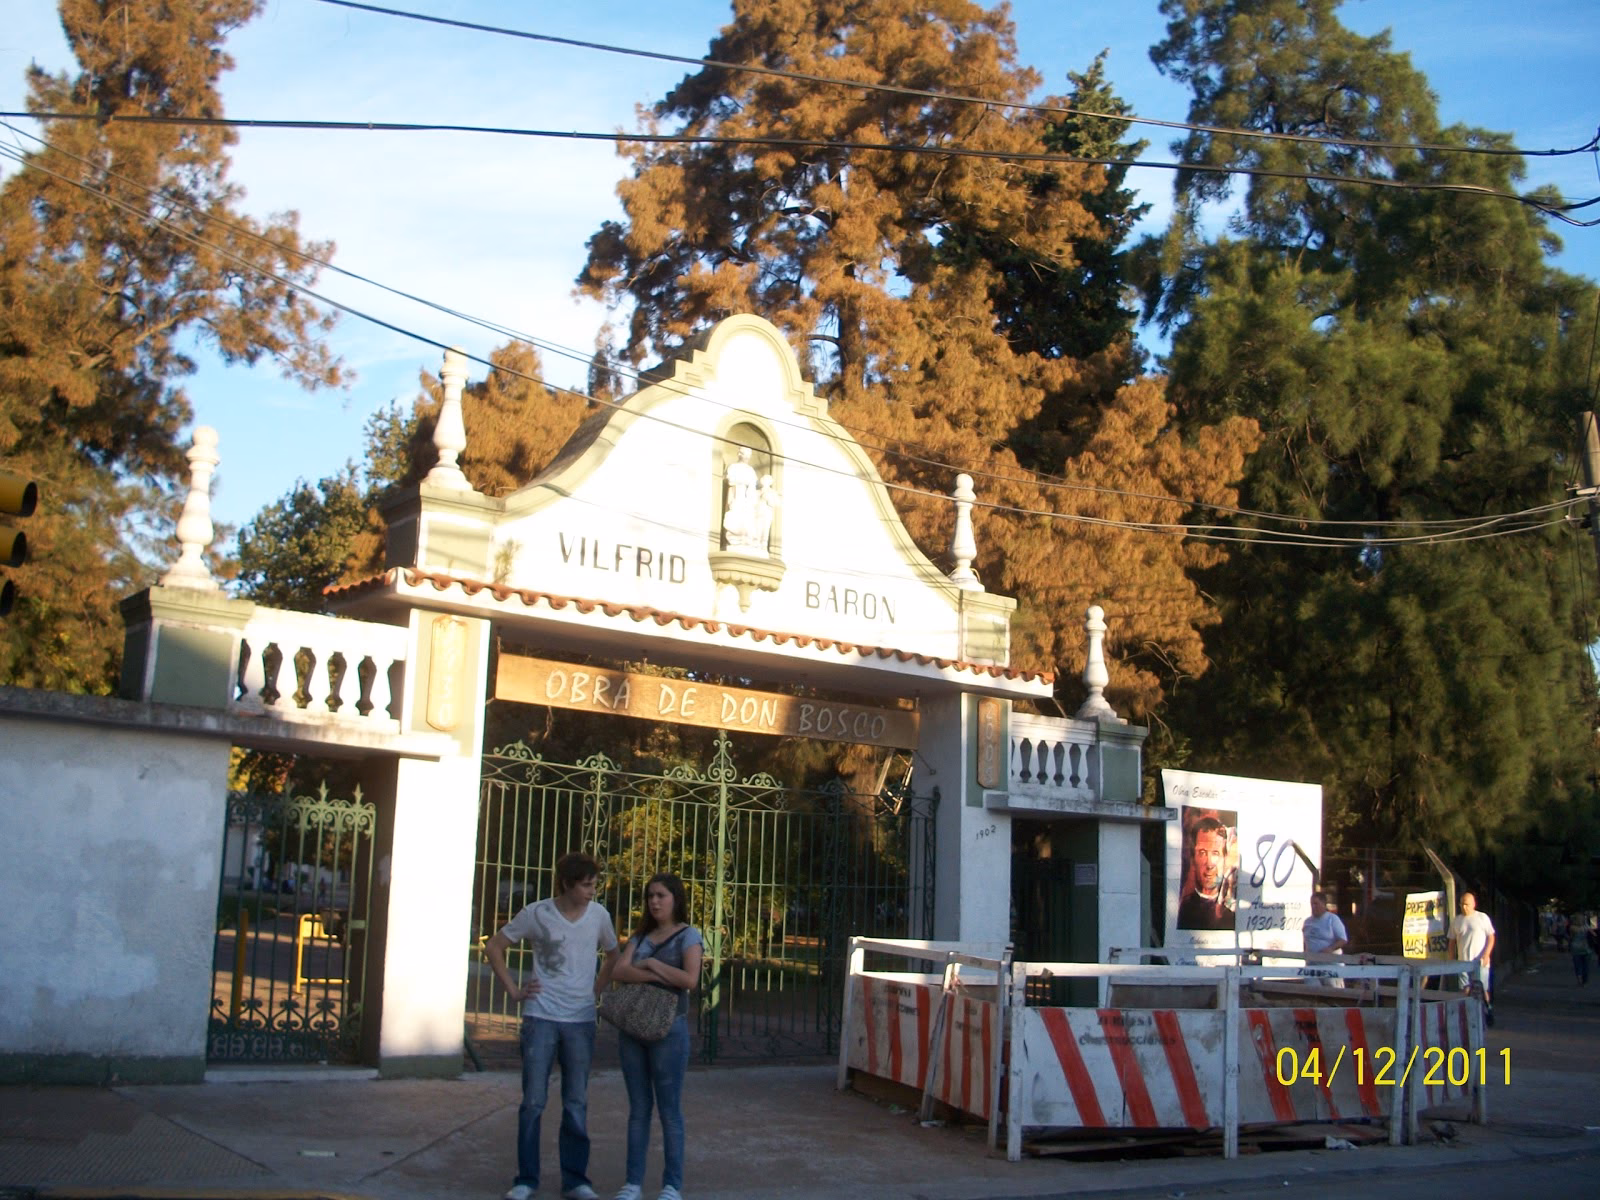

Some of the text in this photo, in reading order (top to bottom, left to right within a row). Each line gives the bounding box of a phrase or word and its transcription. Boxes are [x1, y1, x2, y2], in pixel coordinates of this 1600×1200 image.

[558, 531, 896, 625] VILFRID BARON
[545, 669, 886, 739] OBRA DE DON BOSCO
[975, 824, 997, 841] 1902
[1249, 833, 1297, 889] 80
